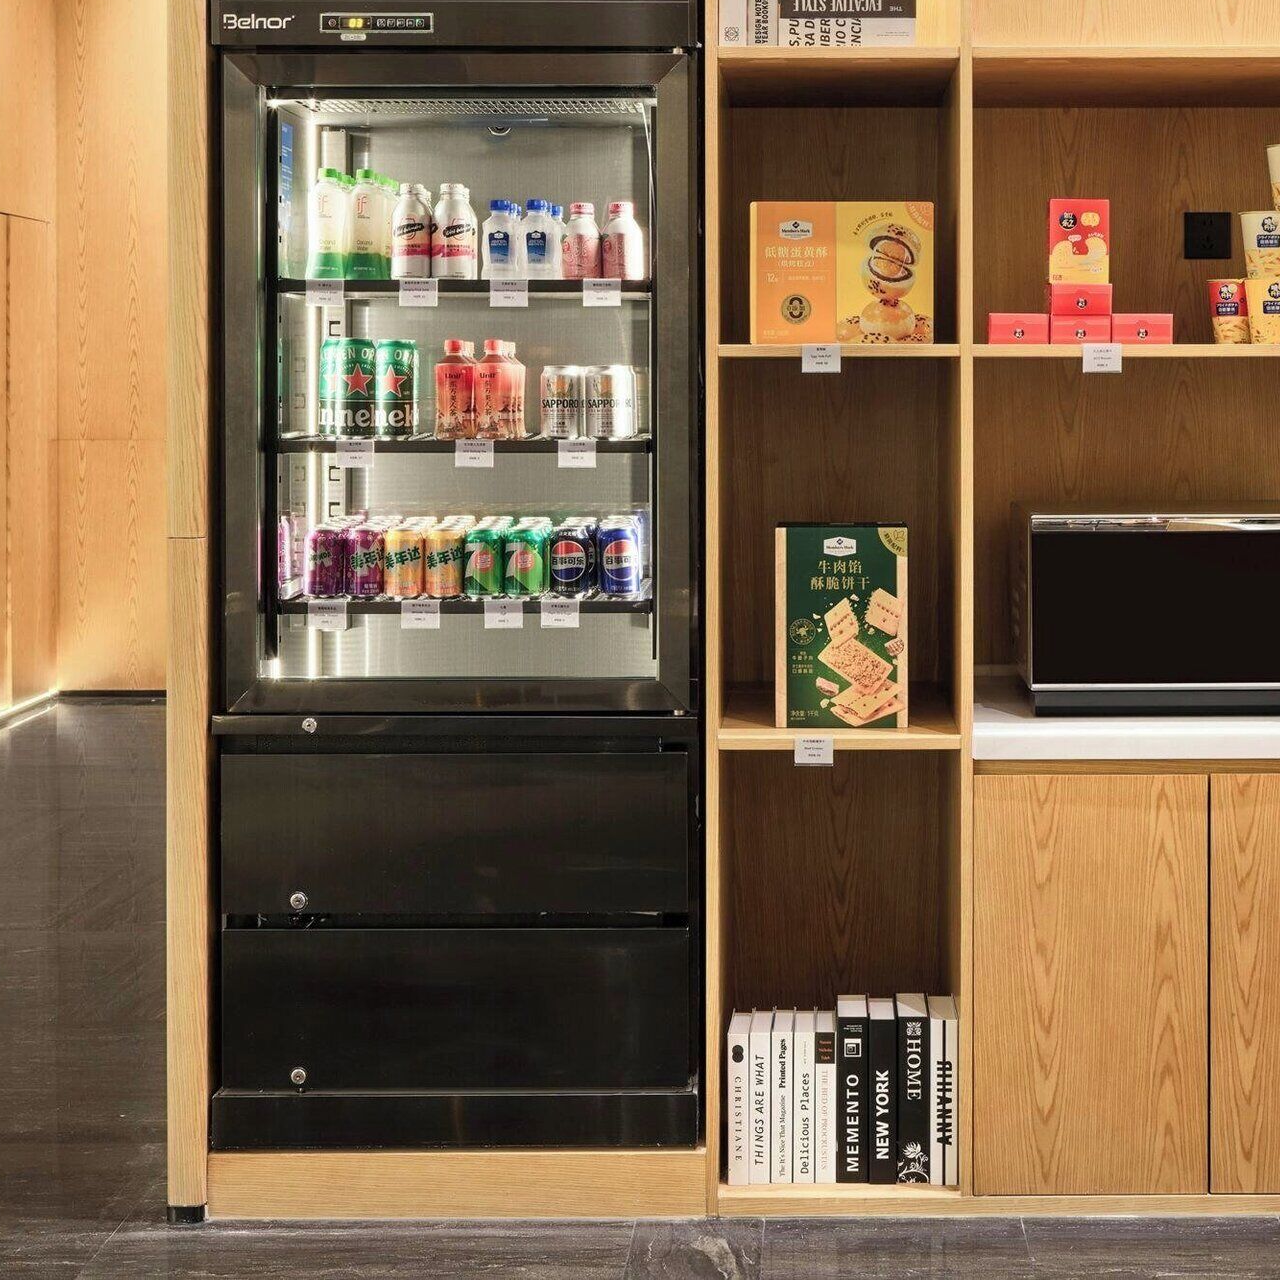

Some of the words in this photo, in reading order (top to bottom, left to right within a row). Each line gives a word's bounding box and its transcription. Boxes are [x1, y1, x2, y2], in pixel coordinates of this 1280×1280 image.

[223, 14, 293, 29] Belnor
[542, 399, 579, 408] SAPPORO
[386, 546, 422, 569] 美年达
[818, 559, 862, 573] 牛肉馅
[810, 577, 870, 590] 酥脆饼干
[779, 1038, 787, 1059] Pages
[755, 1054, 765, 1086] WHAT
[907, 1039, 921, 1100] HOME
[755, 1090, 765, 1115] ARE
[800, 1073, 809, 1110] Places
[876, 1070, 889, 1118] YORK
[734, 1076, 742, 1161] CHRISTIANE
[779, 1095, 787, 1124] Magazine
[846, 1074, 859, 1172] MEMENTO
[755, 1118, 765, 1166] THINGS
[800, 1117, 809, 1174] Delicious
[876, 1121, 889, 1160] NEW
